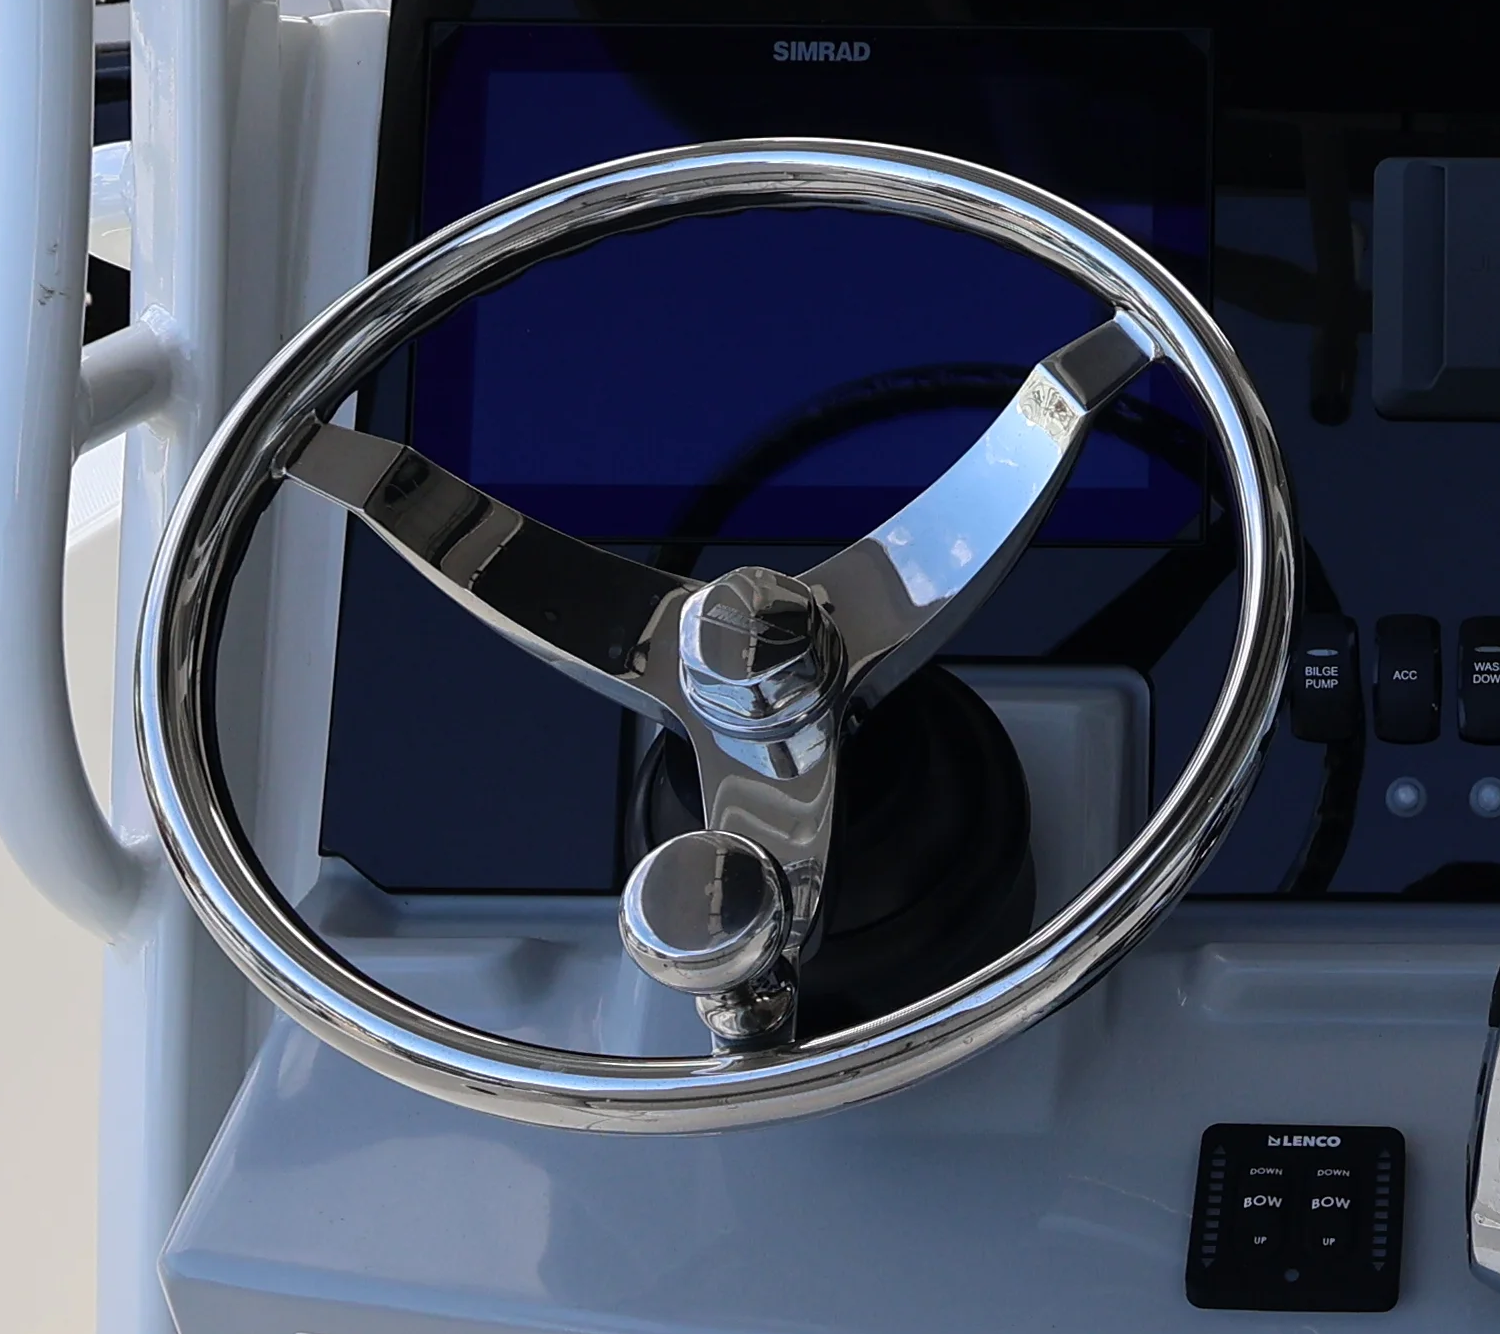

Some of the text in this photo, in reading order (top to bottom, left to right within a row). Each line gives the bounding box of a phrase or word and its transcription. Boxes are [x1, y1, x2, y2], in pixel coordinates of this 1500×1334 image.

[773, 40, 871, 64] SIMRAD
[1305, 666, 1338, 678] BILGE
[1393, 670, 1418, 681] ACC
[1305, 679, 1338, 689] PUMP
[1283, 1135, 1341, 1147] LENCO
[1250, 1167, 1283, 1176] DOWN
[1317, 1168, 1350, 1177] DOWN
[1243, 1194, 1283, 1208] BOW
[1311, 1196, 1351, 1210] BOW
[1254, 1236, 1267, 1245] UP
[1322, 1237, 1336, 1246] UP
